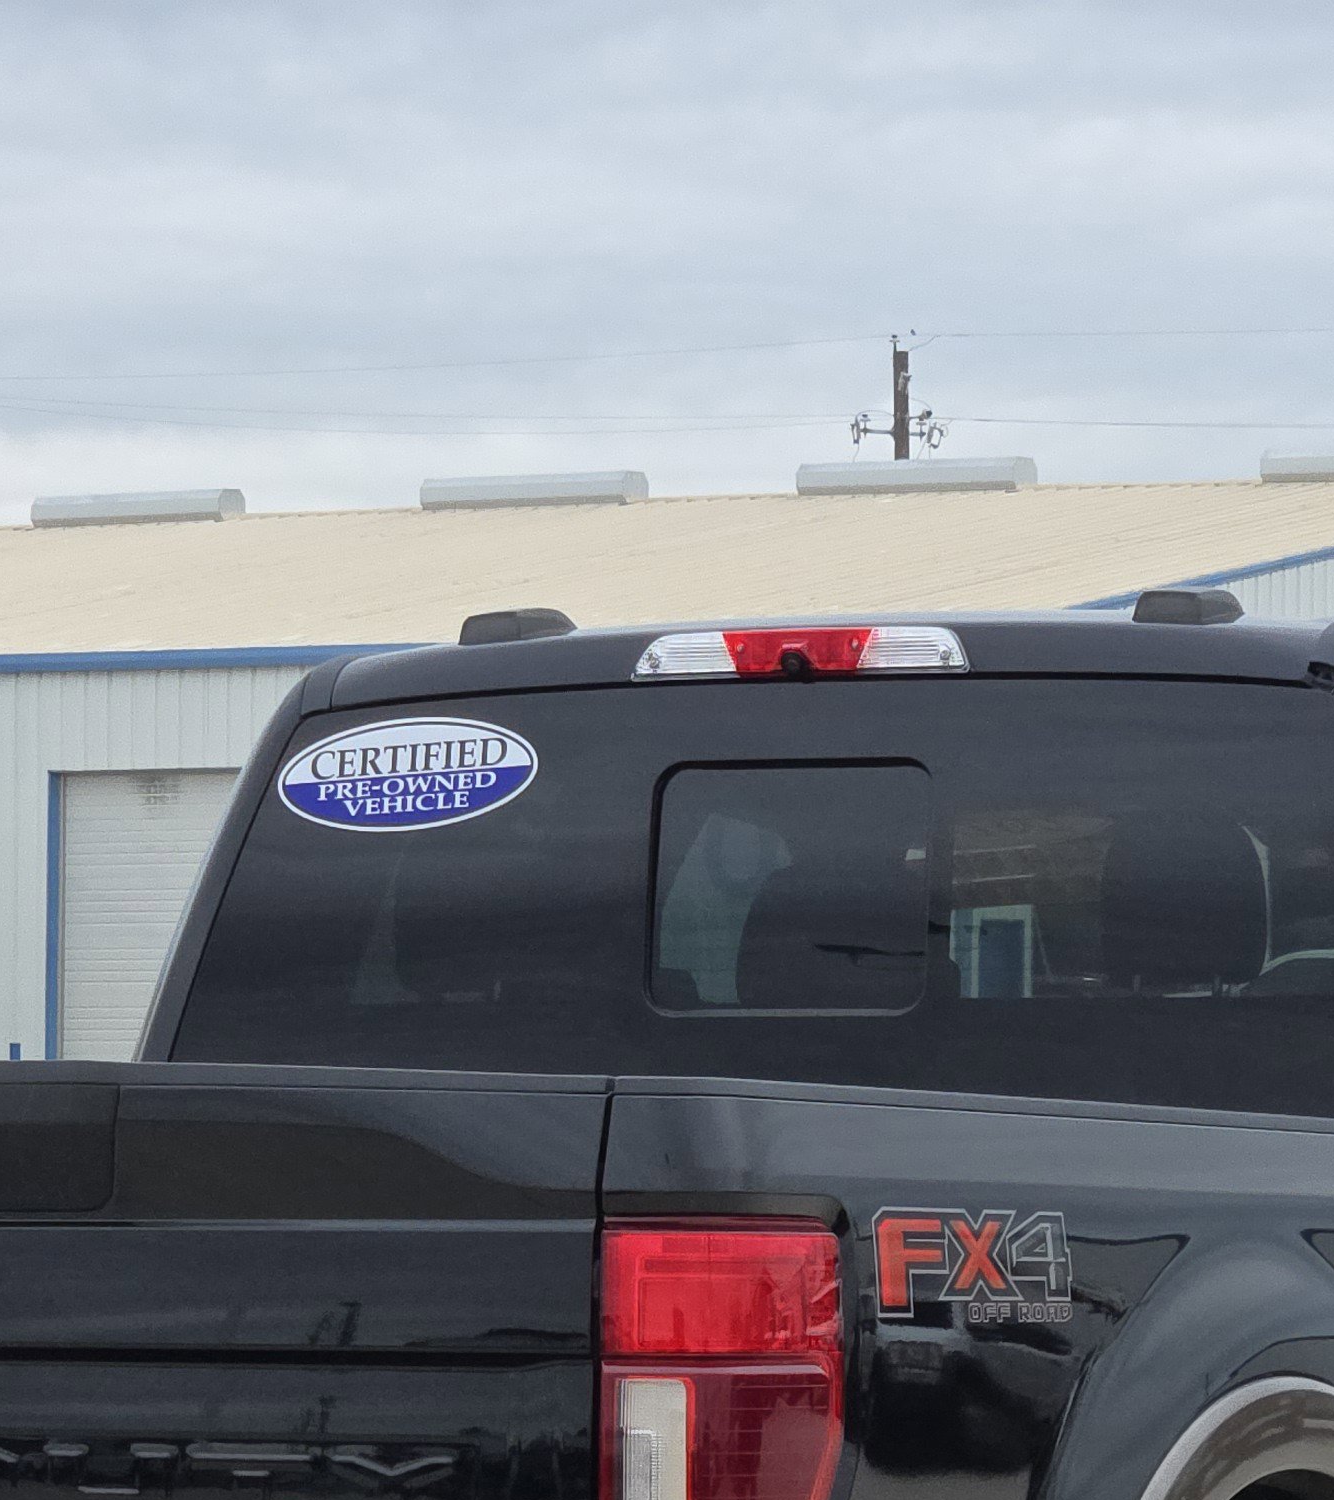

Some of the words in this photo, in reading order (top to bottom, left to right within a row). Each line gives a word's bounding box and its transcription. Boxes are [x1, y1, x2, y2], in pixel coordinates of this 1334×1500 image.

[311, 737, 508, 780] CERTIFIED
[317, 771, 497, 801] PRE-OWNED
[343, 791, 470, 817] VEHICLE
[872, 1206, 1072, 1318] FX4
[968, 1302, 1012, 1324] OFF
[1018, 1302, 1073, 1324] ROAD
